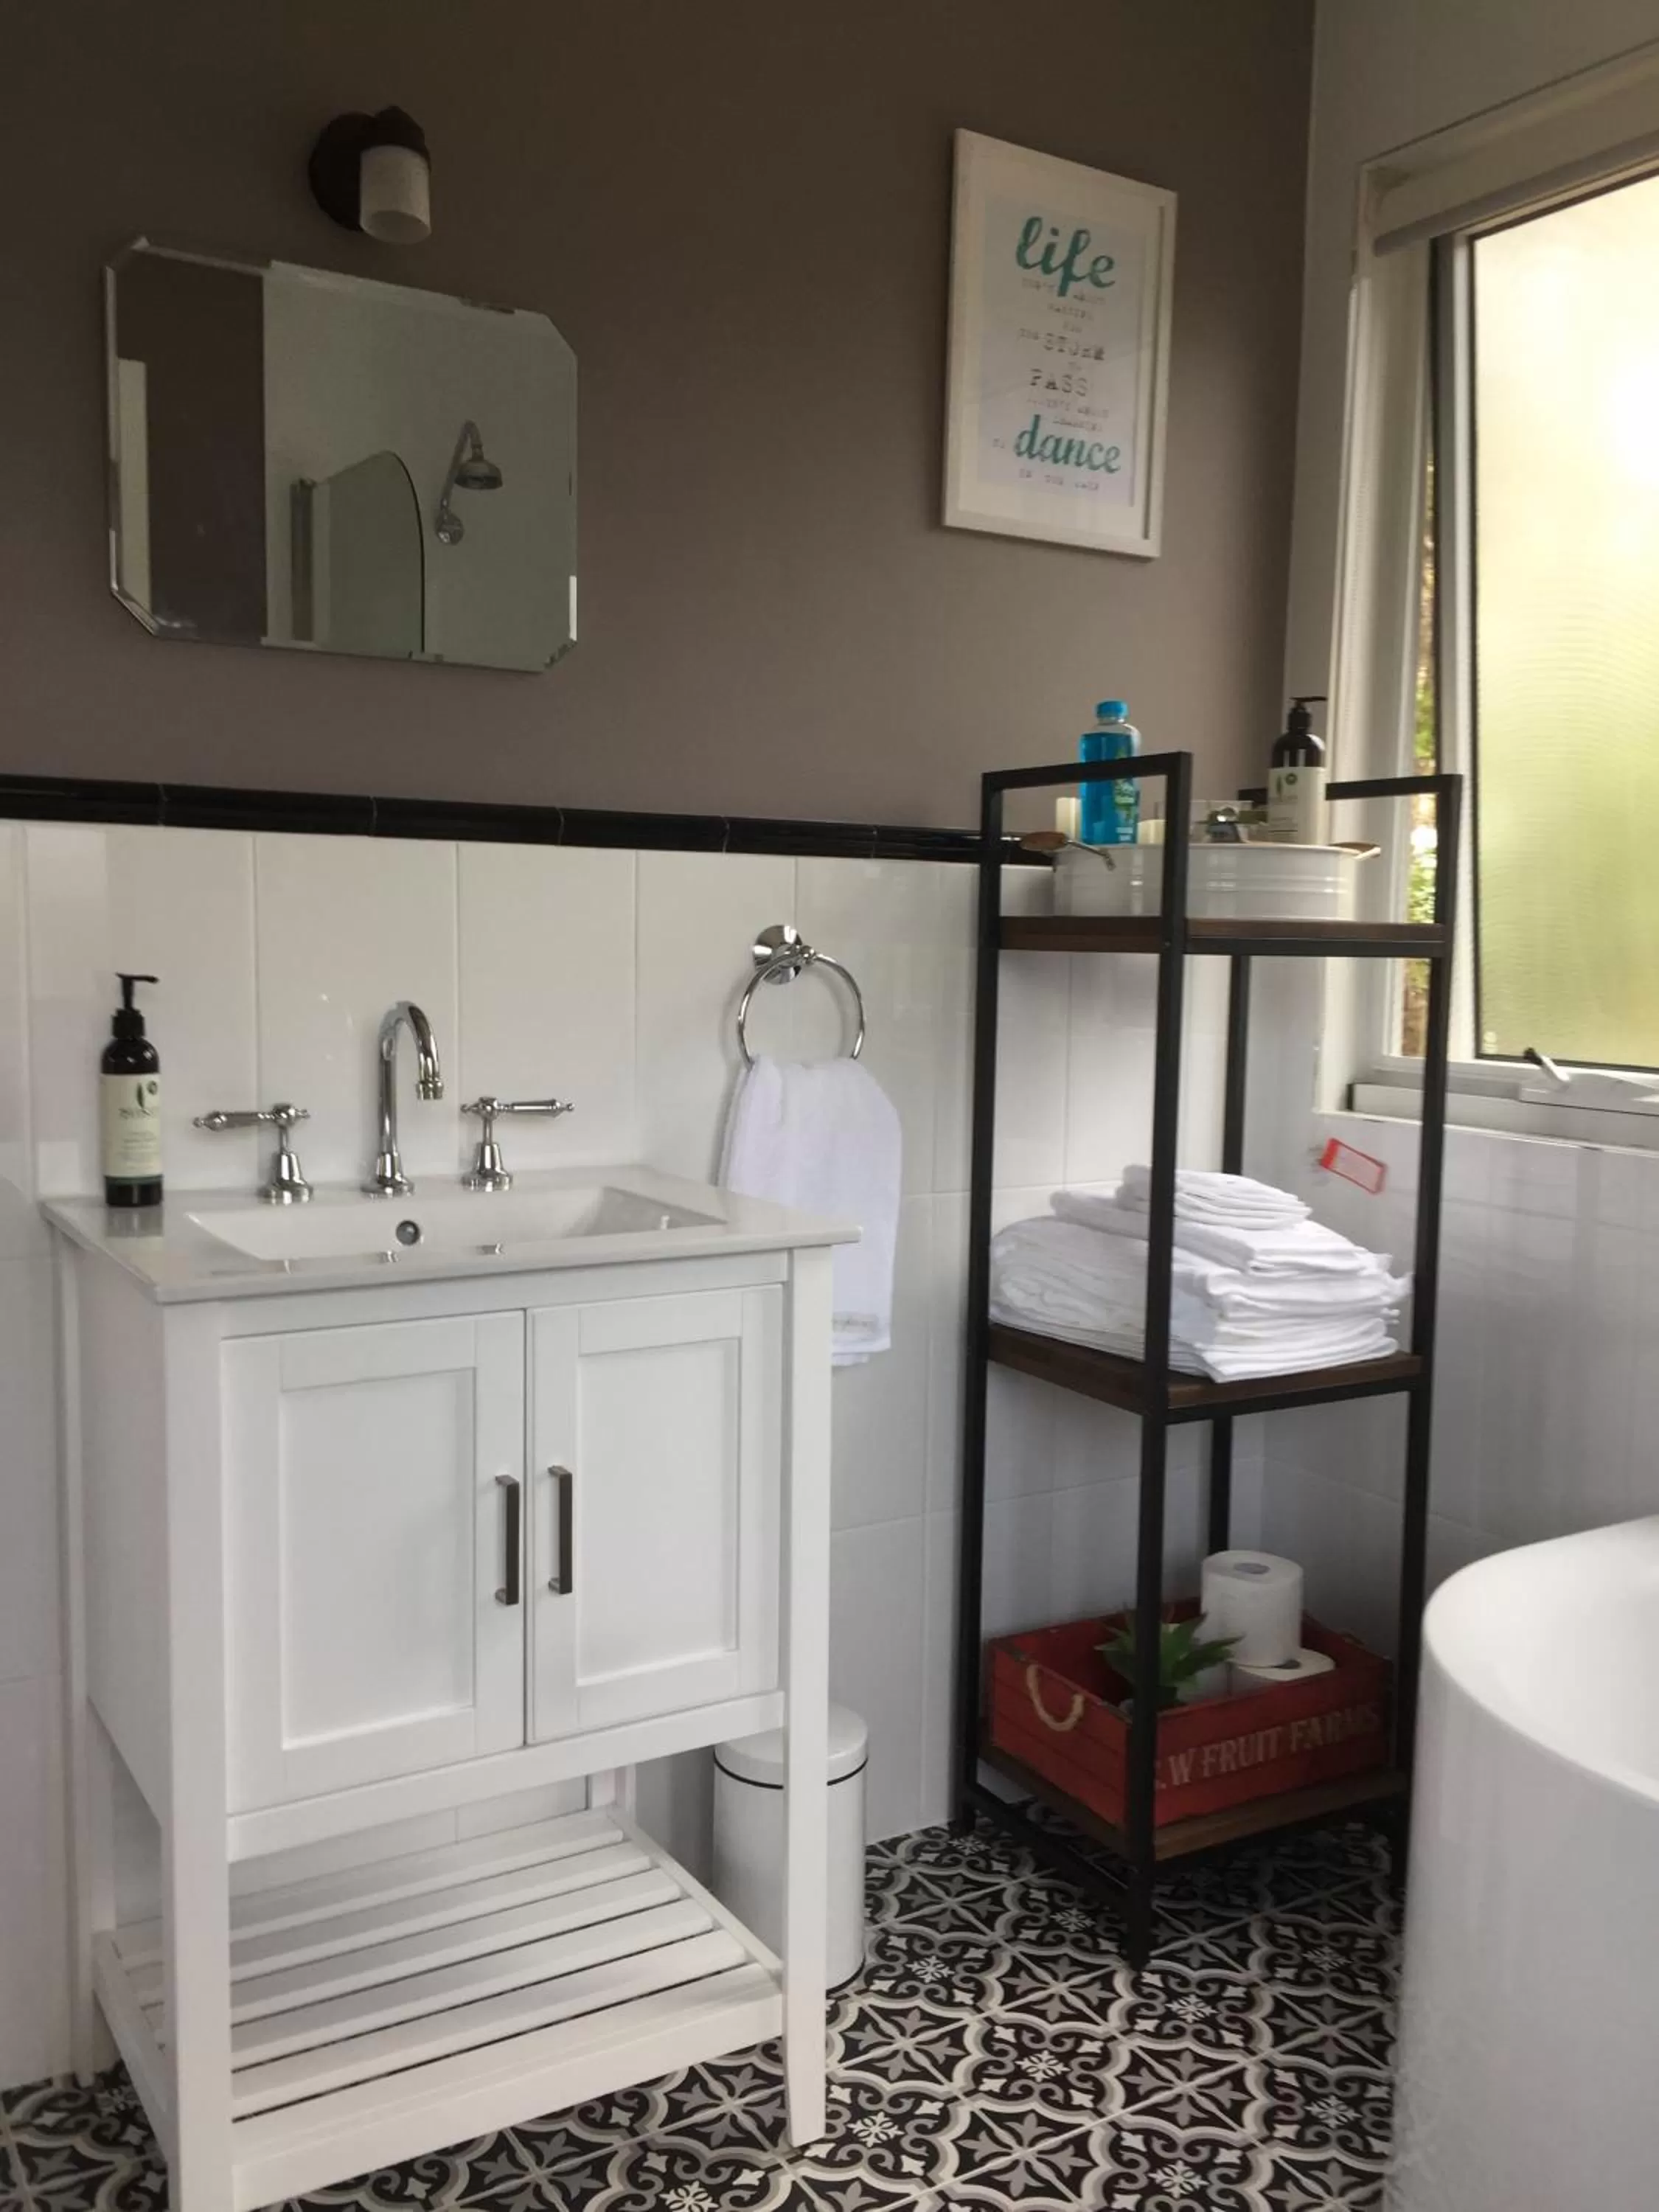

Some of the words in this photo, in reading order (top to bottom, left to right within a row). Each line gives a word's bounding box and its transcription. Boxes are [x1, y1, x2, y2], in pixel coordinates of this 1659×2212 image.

[1015, 215, 1116, 298] life
[1029, 367, 1089, 397] PASS
[1012, 413, 1121, 474] dance
[1201, 1726, 1284, 1778] FRUIT
